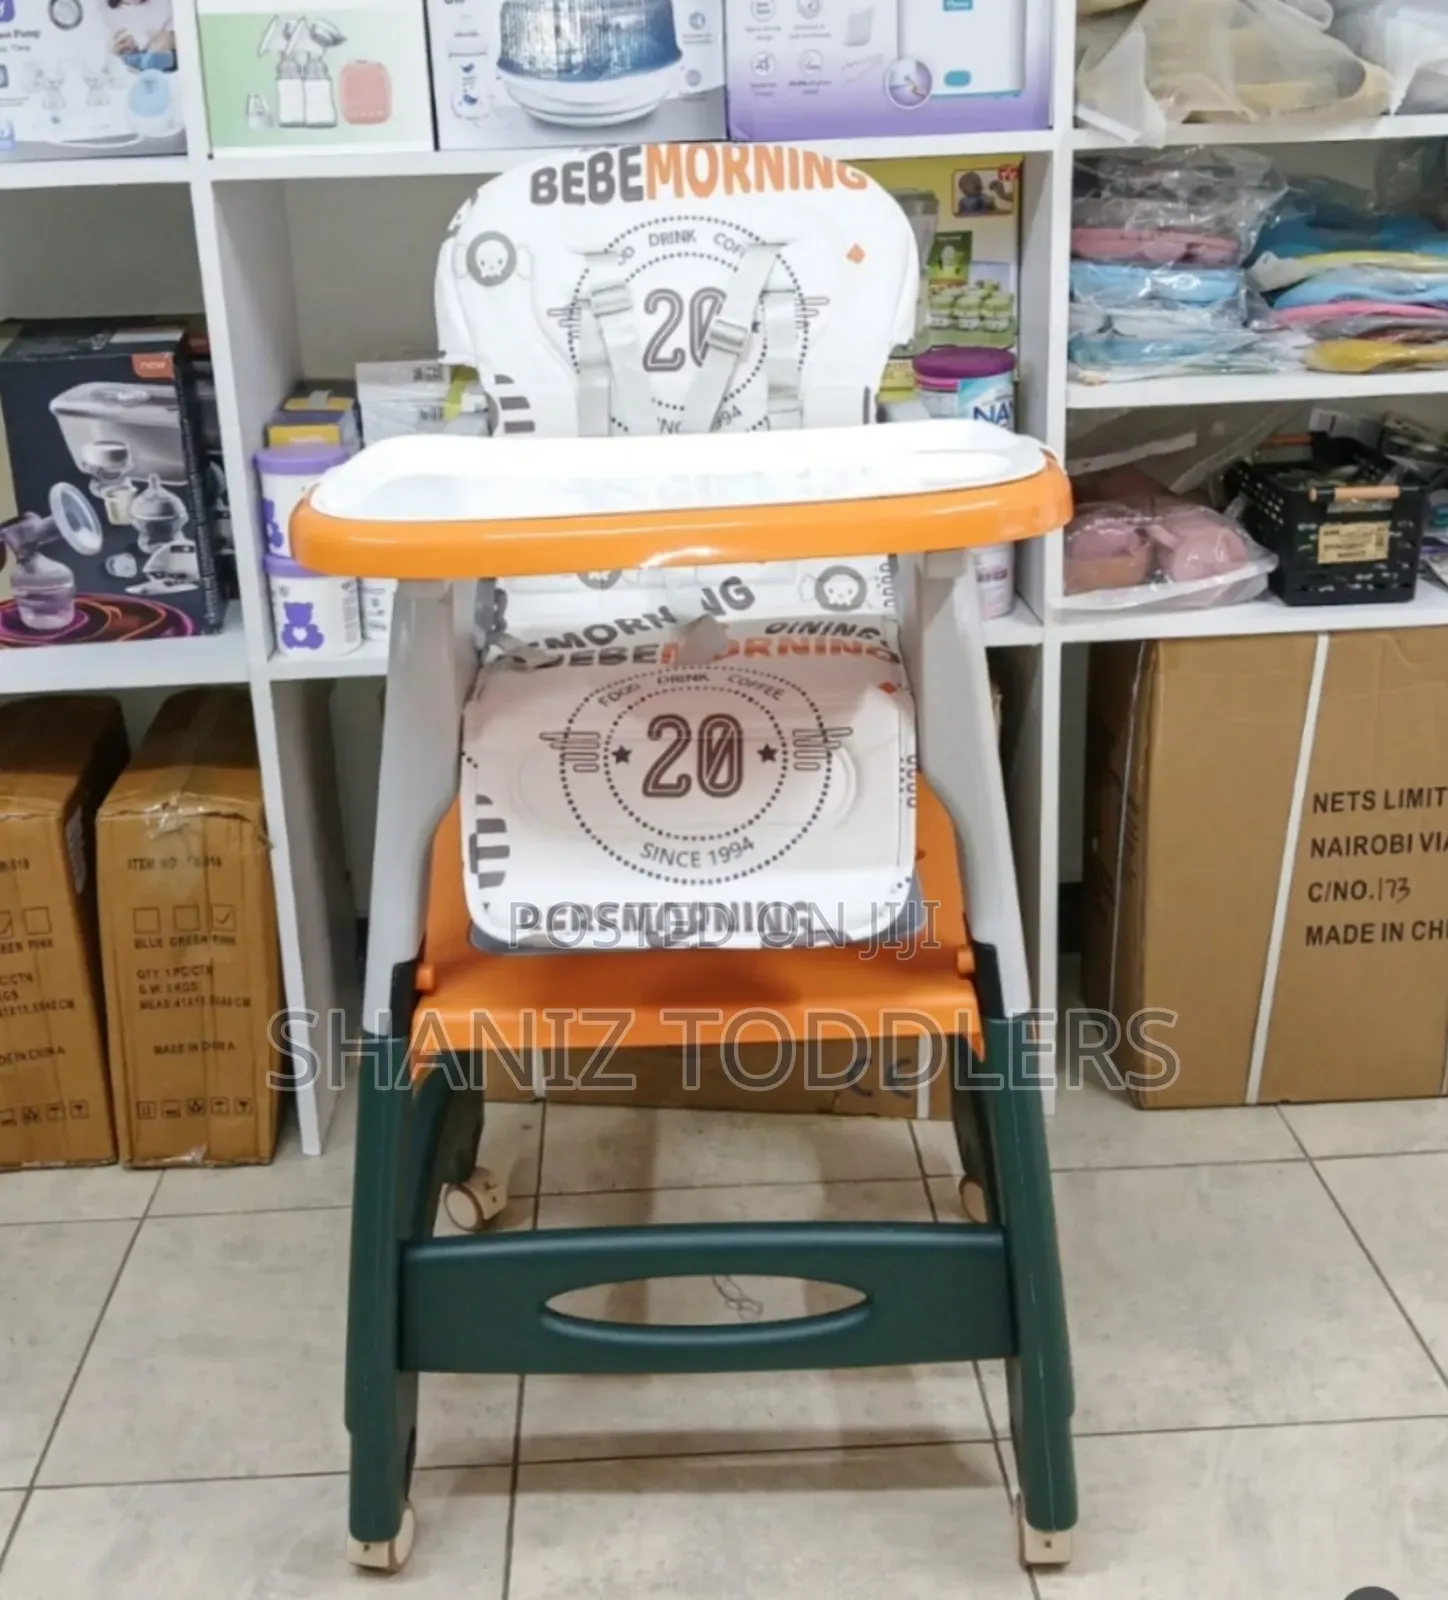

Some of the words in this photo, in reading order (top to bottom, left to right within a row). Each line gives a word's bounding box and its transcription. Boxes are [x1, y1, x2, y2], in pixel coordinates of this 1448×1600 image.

[648, 229, 697, 248] DRINK
[599, 682, 642, 708] FOOD
[656, 672, 710, 686] DRINK
[727, 674, 785, 701] COFFEE
[642, 712, 744, 799] 20
[1312, 789, 1377, 814] NETS
[1383, 786, 1448, 810] LIMIT
[640, 841, 702, 869] SINCE
[708, 836, 756, 865] 1994
[1310, 832, 1414, 859] NAIROBI
[134, 937, 163, 949] BLUE
[170, 934, 208, 948] GREEN
[1305, 922, 1375, 947] MADE
[1381, 921, 1405, 943] IN
